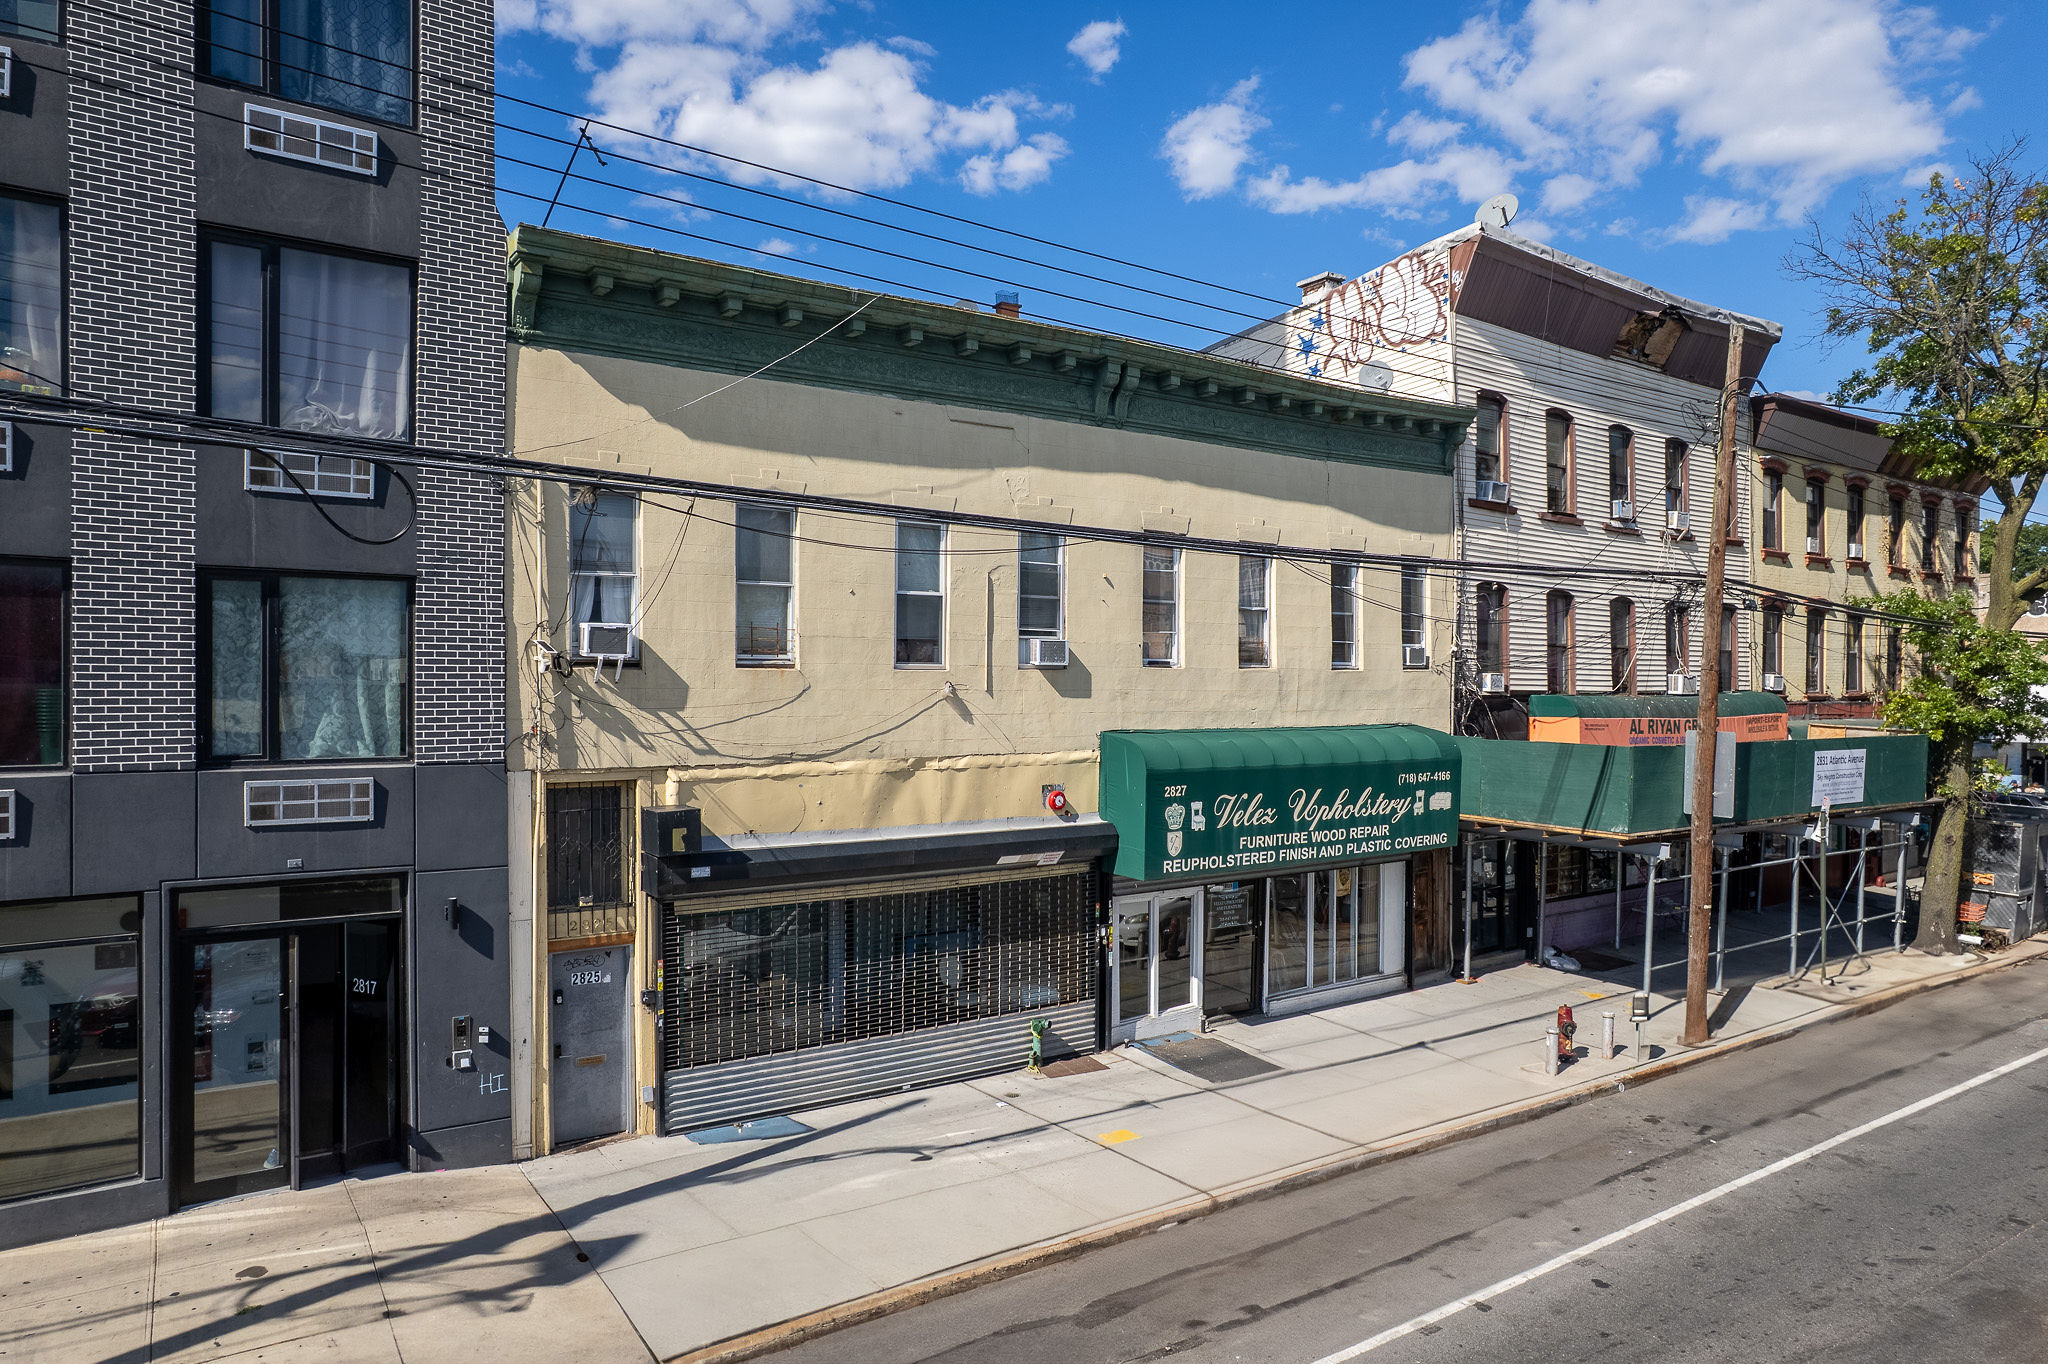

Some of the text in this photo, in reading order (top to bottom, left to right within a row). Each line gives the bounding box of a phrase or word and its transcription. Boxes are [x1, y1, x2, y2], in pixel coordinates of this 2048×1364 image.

[1629, 719, 1644, 735] AL
[1648, 719, 1681, 735] RIYAN
[1652, 736, 1675, 744] COSMETIC
[1830, 754, 1847, 765] Atlantic
[1848, 754, 1864, 763] Avenue
[1398, 771, 1451, 786] (718) 647-4166
[1164, 785, 1187, 797] 2827
[1214, 786, 1412, 831] Velez Upholstery
[1239, 824, 1390, 850] FURNITURE WOOD REPAIR
[1163, 832, 1448, 873] REUPHOLSTERED FINISH AND PLASTIC COVERING
[572, 971, 600, 985] 2825
[353, 977, 377, 995] 2817
